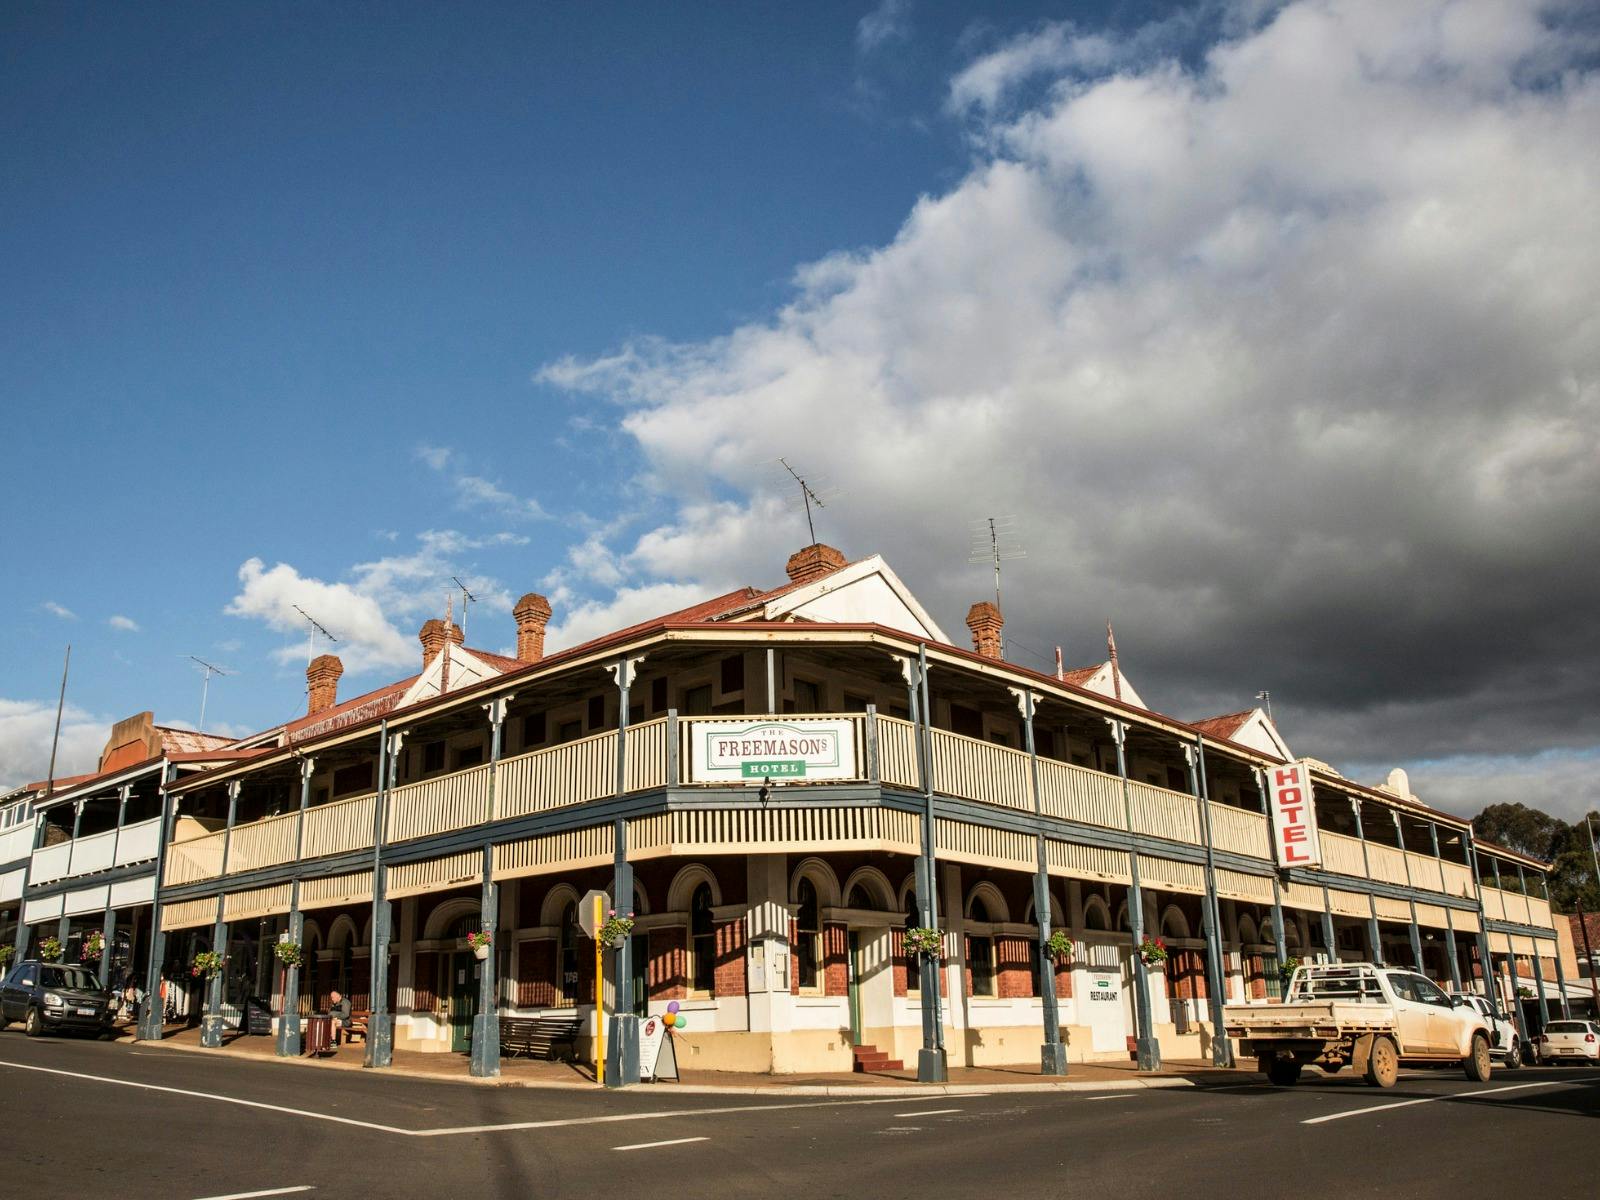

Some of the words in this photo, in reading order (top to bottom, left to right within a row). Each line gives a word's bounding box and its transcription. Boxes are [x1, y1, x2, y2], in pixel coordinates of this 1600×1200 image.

[718, 739, 828, 757] FREEMASONS
[750, 764, 799, 774] HOTEL
[1275, 767, 1310, 862] HOTEL
[1090, 991, 1118, 1001] RESTAURANT
